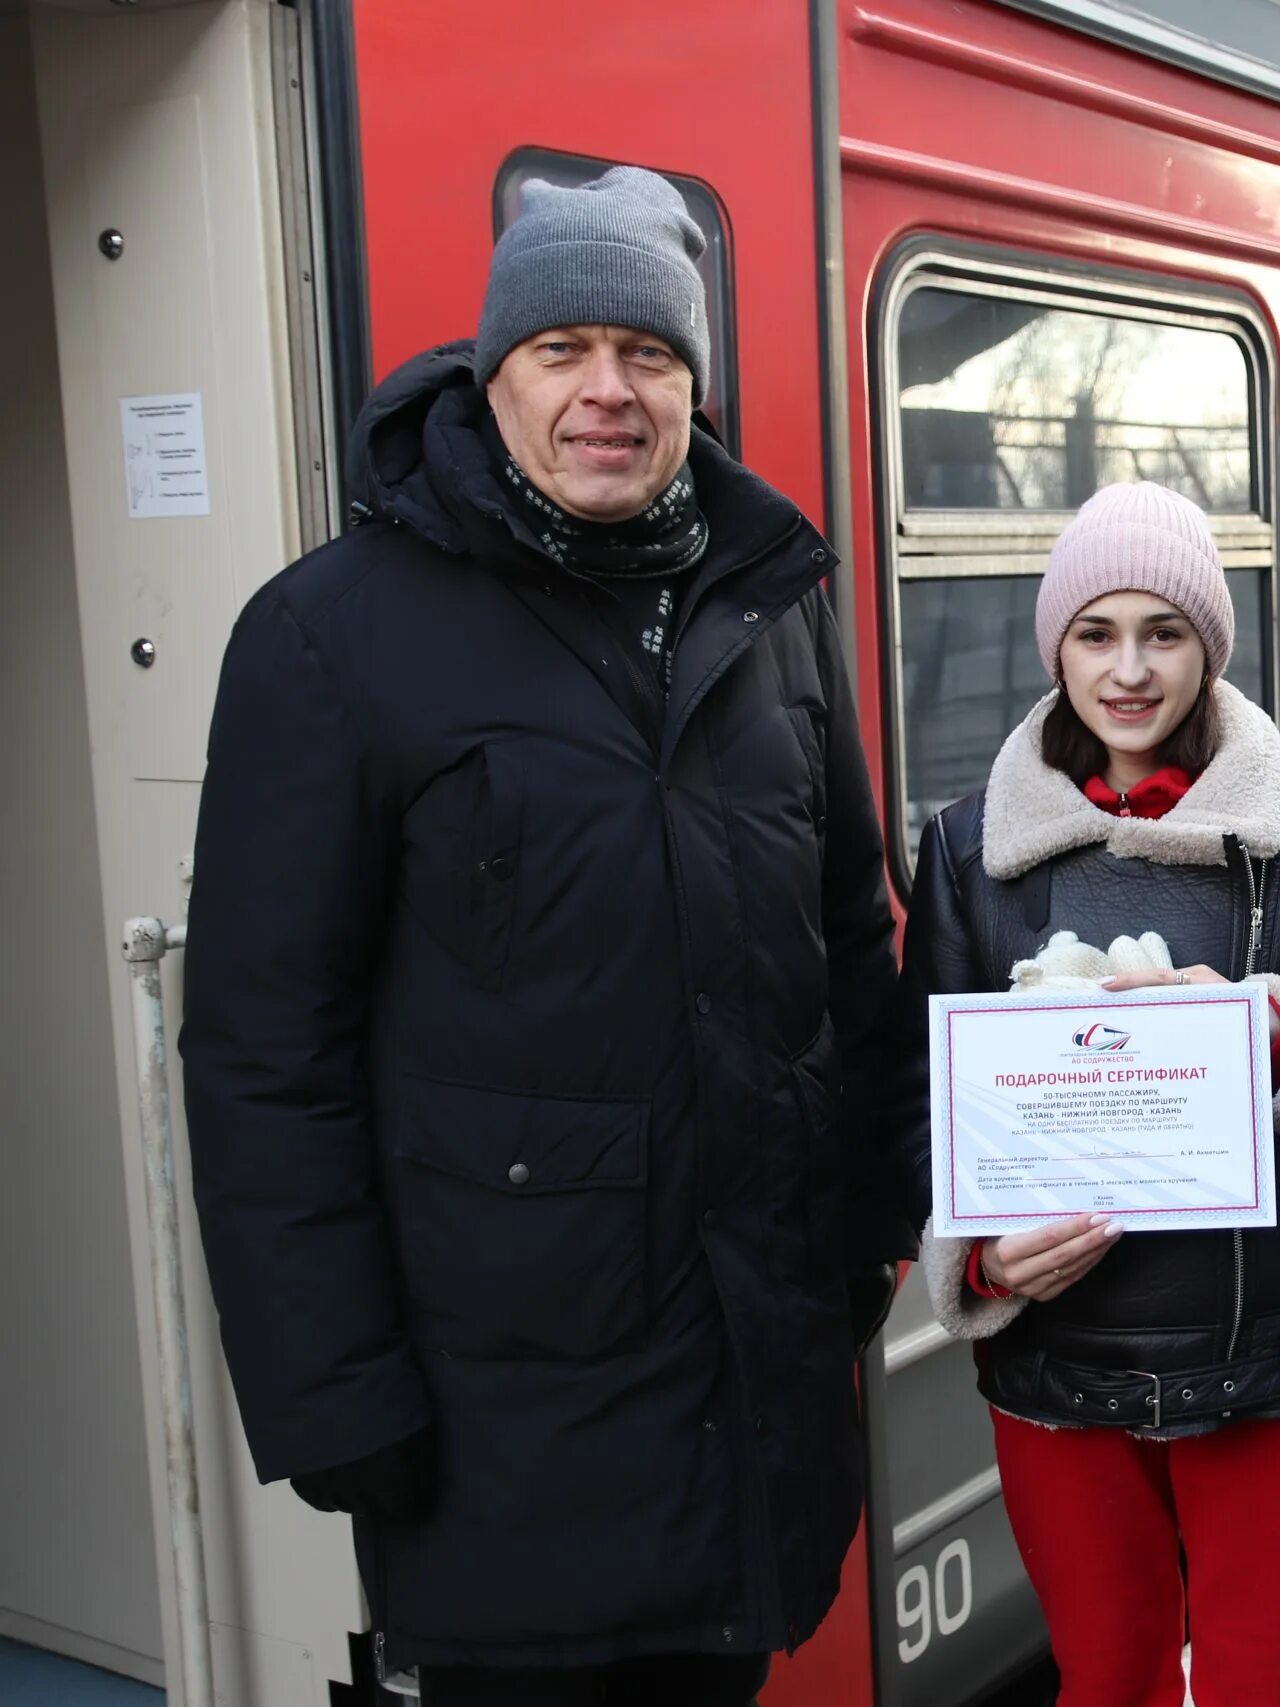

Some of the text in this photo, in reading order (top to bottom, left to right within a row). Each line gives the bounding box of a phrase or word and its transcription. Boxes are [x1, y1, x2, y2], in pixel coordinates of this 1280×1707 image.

[1083, 1056, 1134, 1064] СОДРУЖЕСТВО
[995, 1067, 1208, 1088] ПОДАРОЧНЫЙ СЕРТИФИКАТ
[1043, 1089, 1161, 1100] 50-ТЫСЯЧНОМУ ПАССАЖИРУ,
[1016, 1101, 1087, 1110] СОВЕРШИВШЕМУ
[1089, 1099, 1126, 1108] ПОЕЗДКУ
[1142, 1097, 1188, 1105] МАРШРУТУ
[1023, 1112, 1055, 1120] КАЗАНЬ
[1061, 1109, 1098, 1118] НИЖНИЙ
[1100, 1108, 1144, 1117] НОВГОРОД
[1150, 1107, 1182, 1115] КАЗАНЬ
[1041, 1126, 1071, 1134] НИЖНИЙ
[896, 1538, 972, 1663] 90
